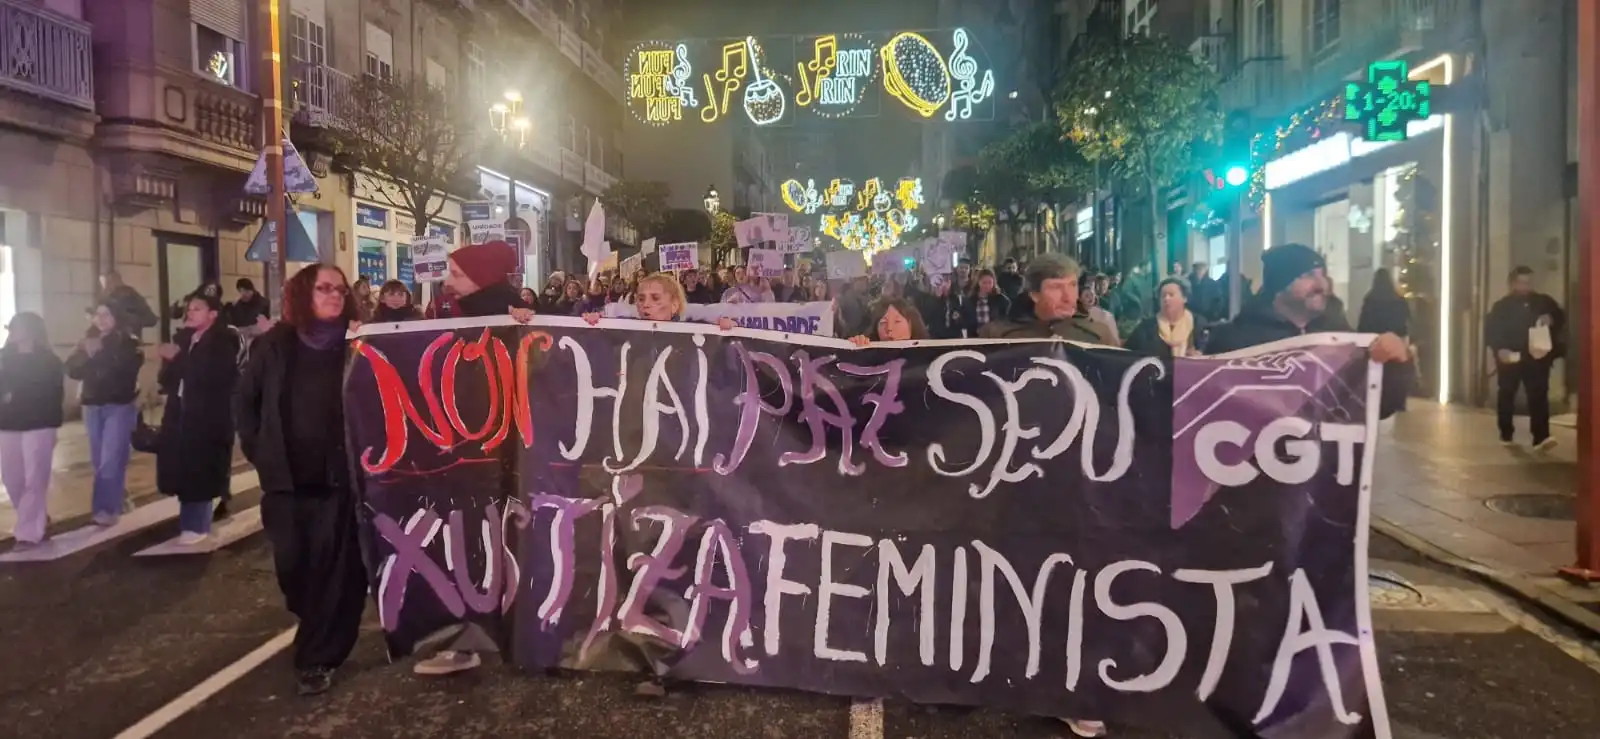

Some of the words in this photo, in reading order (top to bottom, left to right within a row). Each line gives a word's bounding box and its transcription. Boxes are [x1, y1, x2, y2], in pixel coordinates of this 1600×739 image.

[820, 78, 855, 104] RIN
[836, 50, 871, 76] RIN
[558, 333, 709, 474] HAI
[713, 341, 909, 476] PAZ
[926, 350, 1165, 498] SEN
[1194, 416, 1365, 486] CGT
[749, 519, 1362, 725] FEMINISTA
